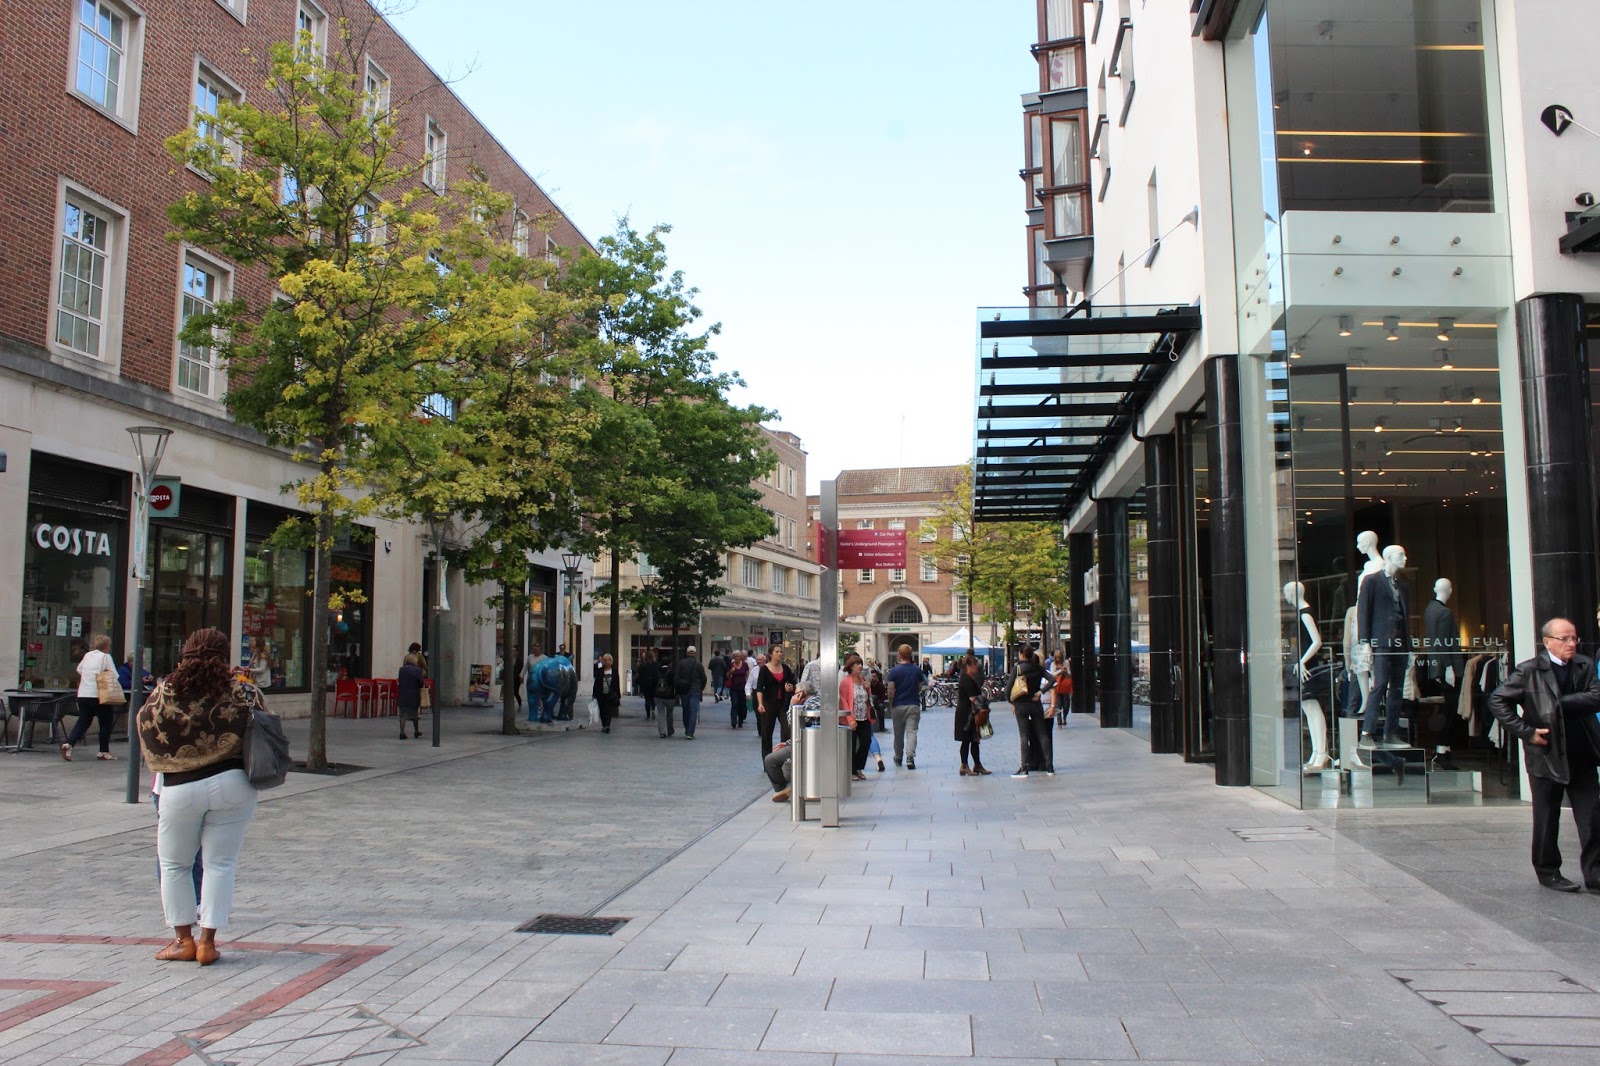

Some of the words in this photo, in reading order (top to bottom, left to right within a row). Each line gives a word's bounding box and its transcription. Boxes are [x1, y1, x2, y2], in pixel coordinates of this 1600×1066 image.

[35, 523, 111, 556] COSTA
[1388, 638, 1402, 647] IS
[1411, 637, 1503, 647] BEAUTIFUL
